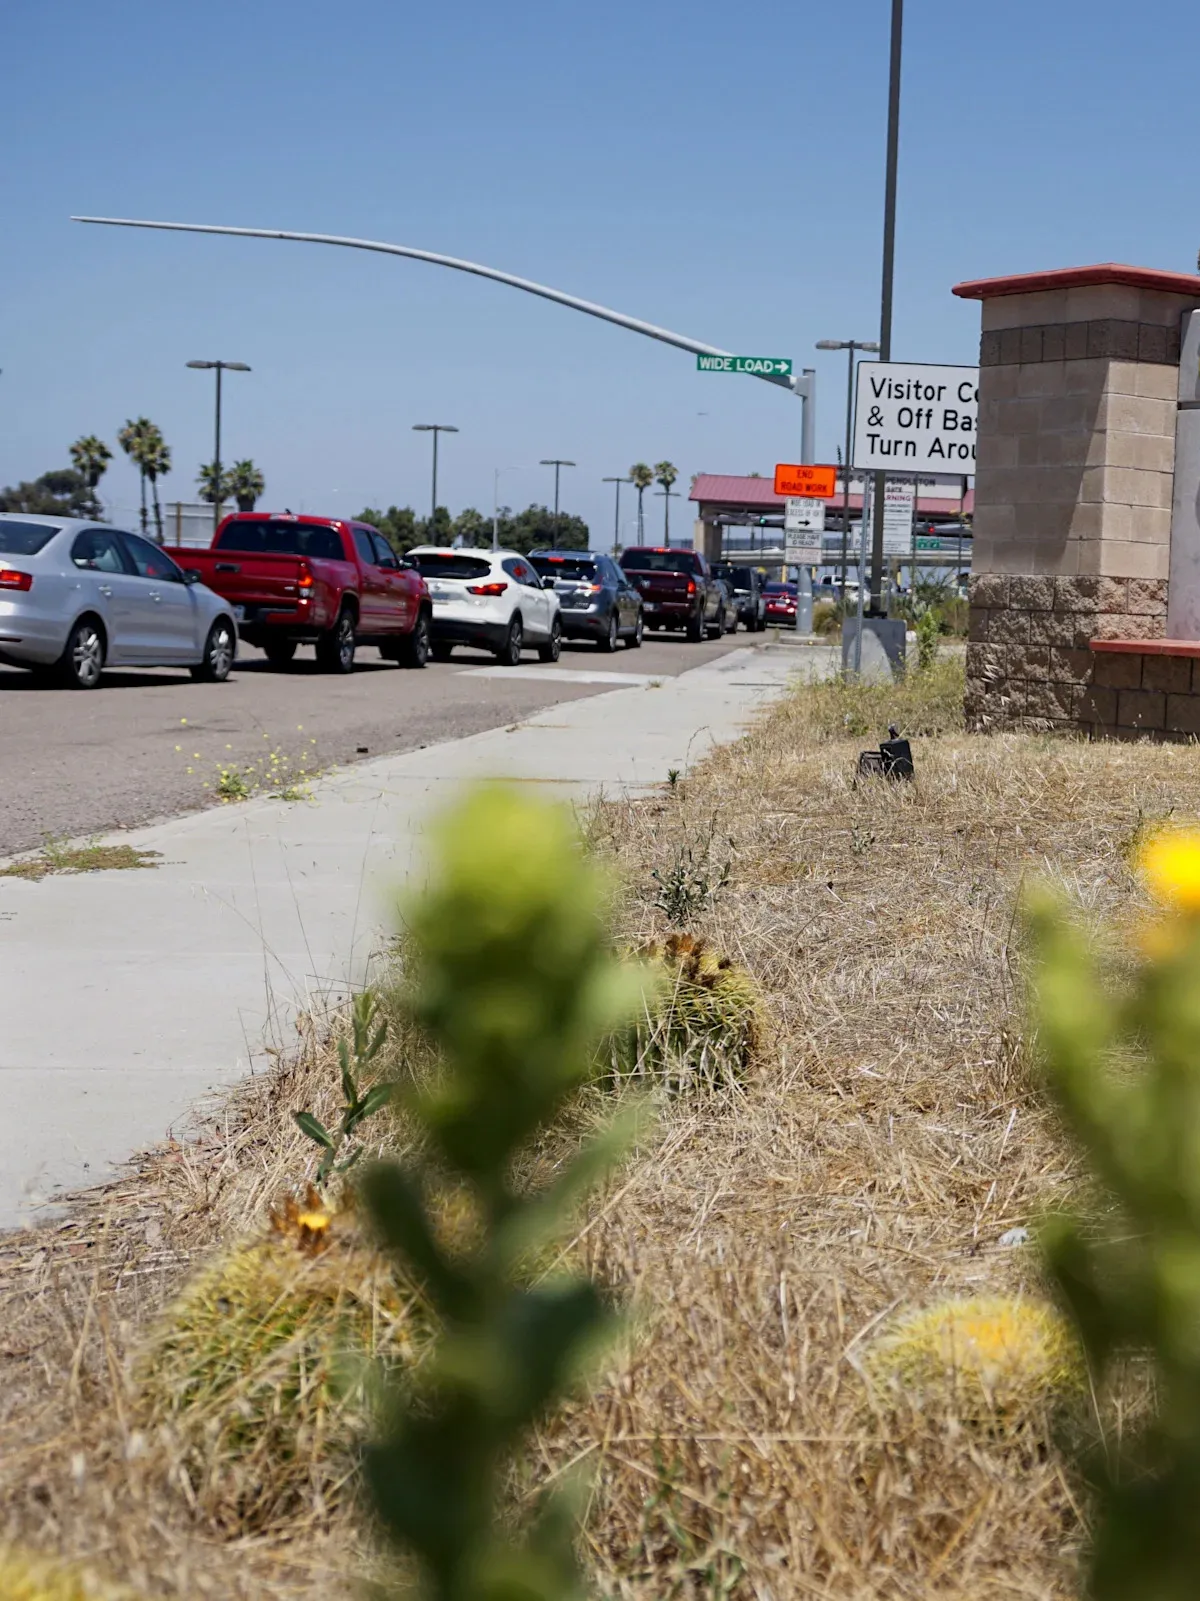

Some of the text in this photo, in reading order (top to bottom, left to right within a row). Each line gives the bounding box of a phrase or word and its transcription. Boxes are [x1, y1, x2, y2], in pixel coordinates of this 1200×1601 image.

[700, 357, 774, 373] WIDE LOAD
[870, 377, 947, 402] Visitor
[867, 405, 884, 427] &
[897, 407, 933, 429] Off
[866, 433, 917, 457] Turn
[797, 469, 814, 479] END
[781, 482, 827, 493] ROAD WORK
[885, 494, 911, 502] RNING
